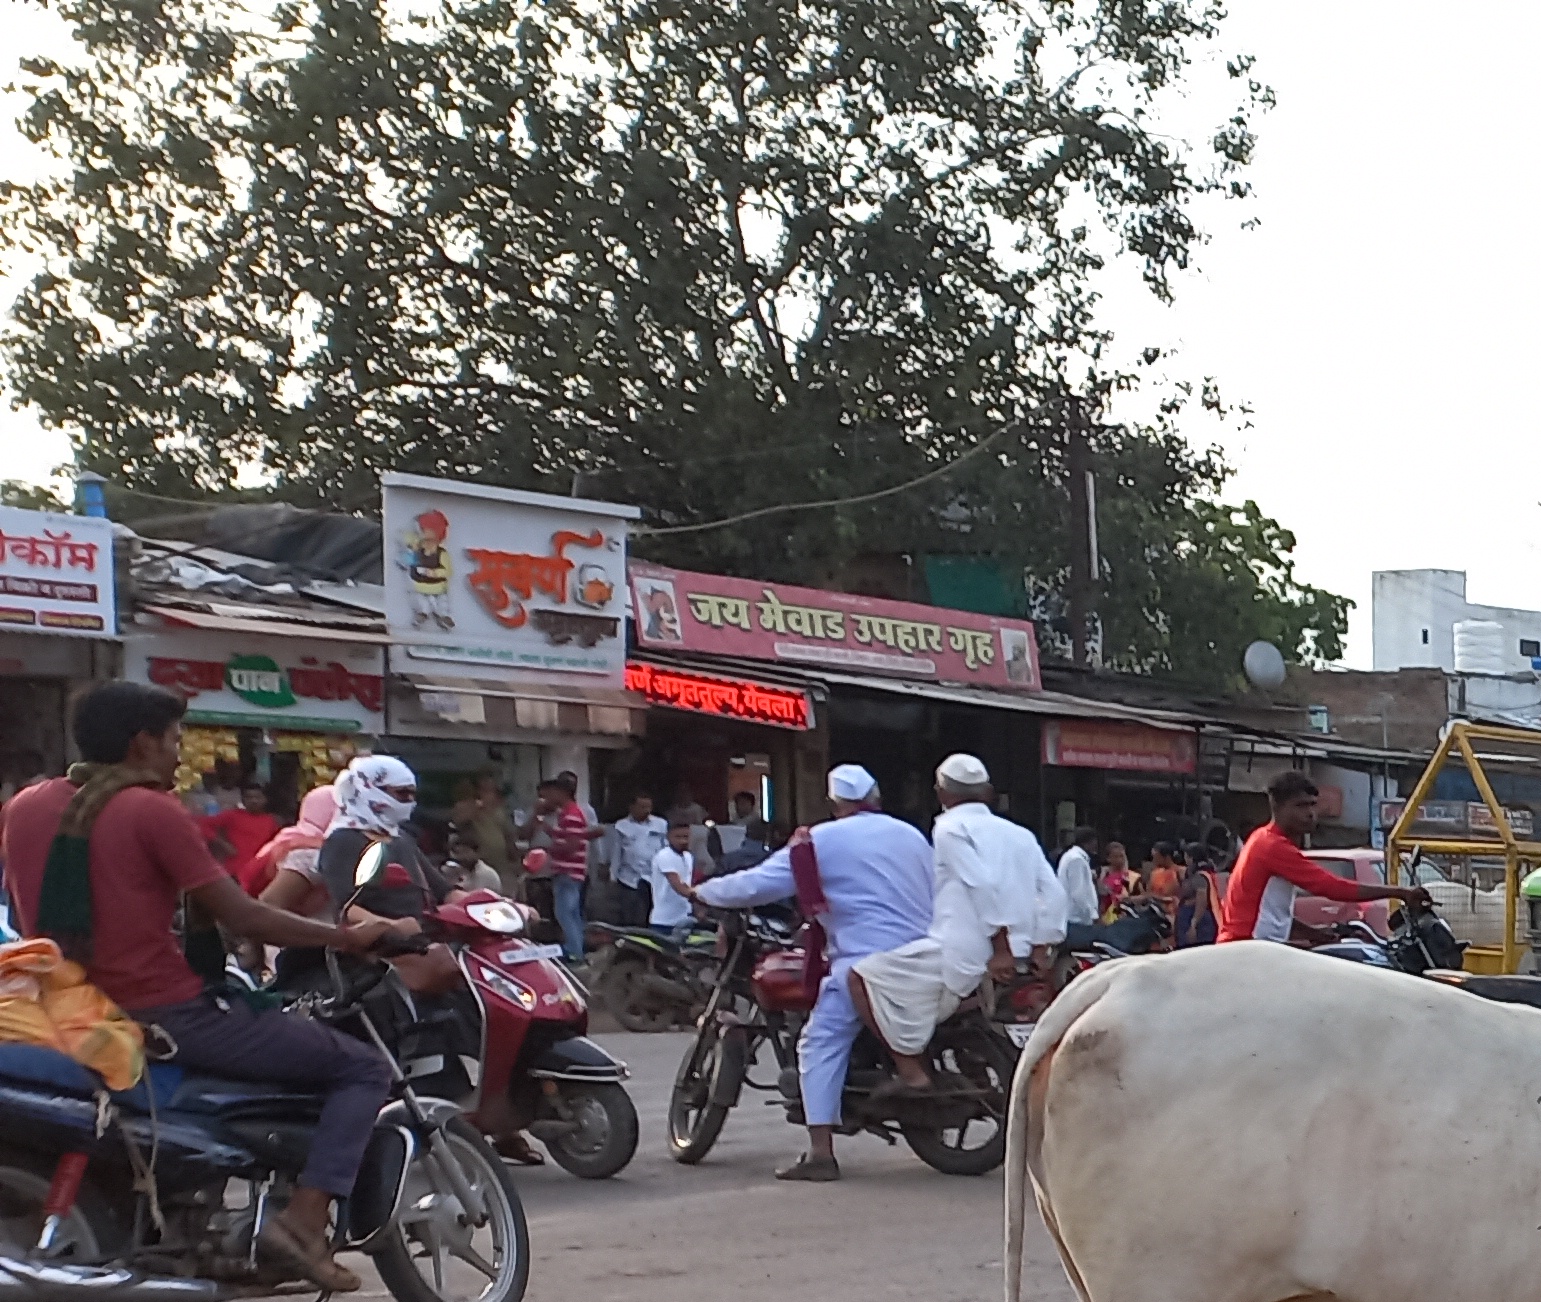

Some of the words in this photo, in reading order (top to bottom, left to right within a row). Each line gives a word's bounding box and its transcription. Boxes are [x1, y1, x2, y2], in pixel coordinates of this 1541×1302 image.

[465, 529, 603, 630] सुवर्ण
[687, 591, 751, 630] जय
[758, 589, 846, 640] मेवाड
[850, 613, 943, 654] उपहार
[946, 625, 995, 671] गृह
[229, 668, 281, 695] पान
